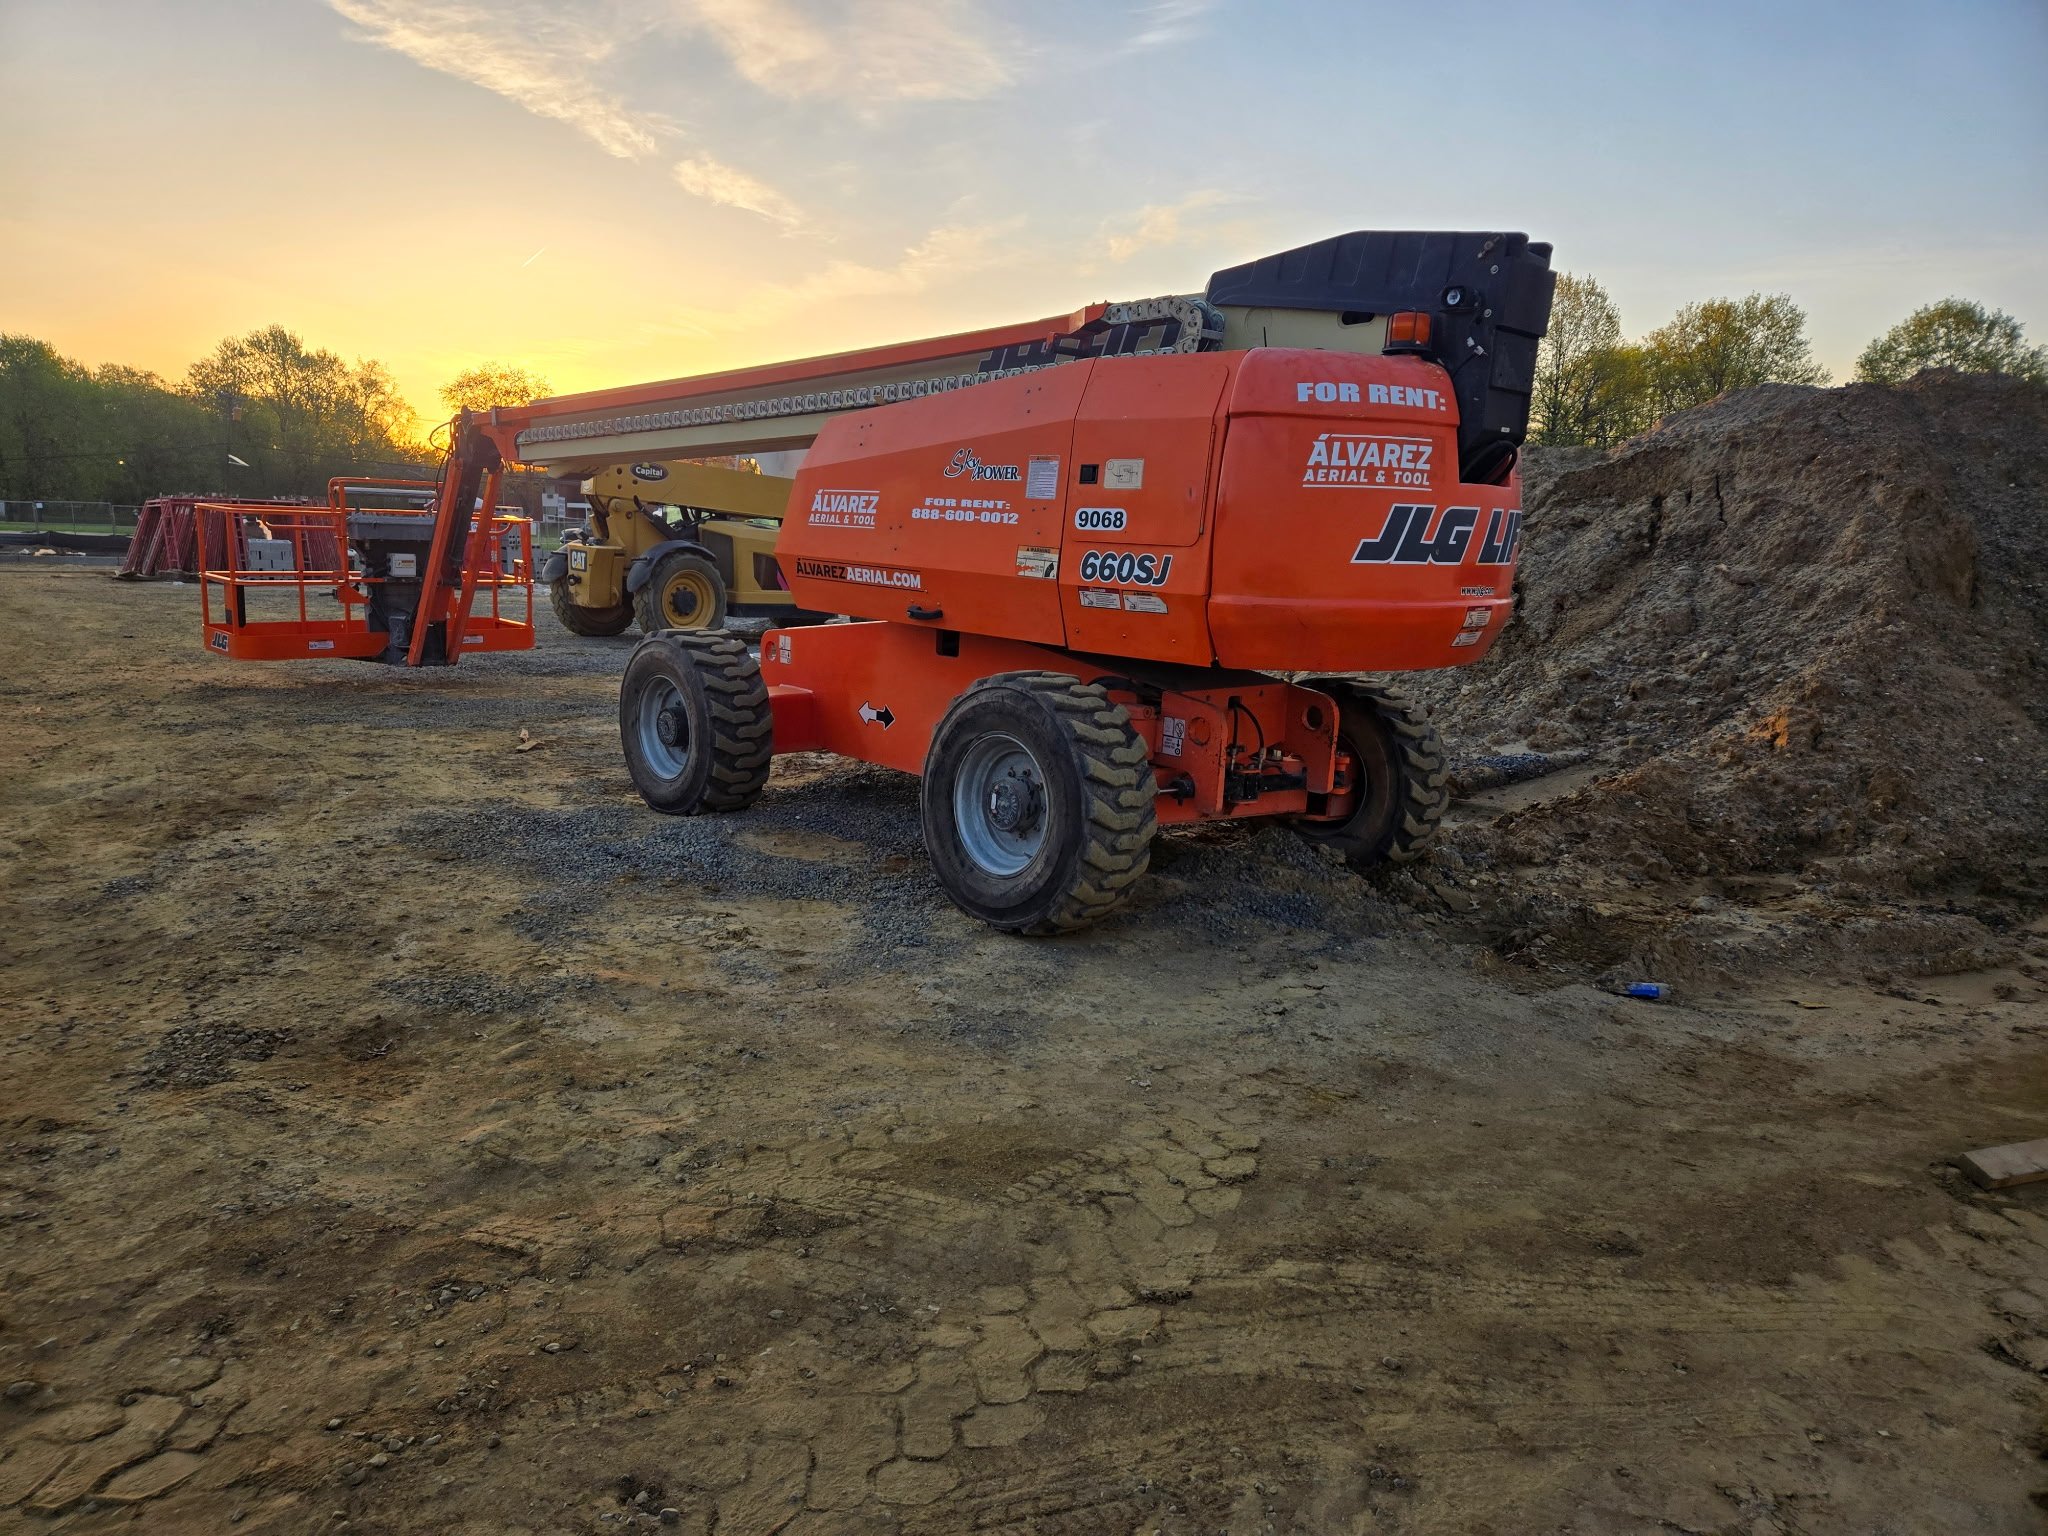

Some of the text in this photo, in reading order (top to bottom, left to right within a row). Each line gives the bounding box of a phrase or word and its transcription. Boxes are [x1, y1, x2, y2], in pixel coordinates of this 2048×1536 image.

[1297, 382, 1446, 411] FOR RENT:
[1306, 433, 1433, 470] ÁLVAREZ
[635, 466, 663, 476] Capital
[1303, 469, 1430, 485] AERIAL & TOOL
[811, 489, 879, 514] ÁLVAREZ
[924, 497, 1011, 510] FOR RENT:
[808, 513, 876, 526] AERIAL & TOOL
[911, 508, 1019, 525] 888-600-0012
[1078, 510, 1124, 528] 9068
[1351, 503, 1480, 566] JLG
[571, 551, 586, 570] CAT
[1080, 550, 1173, 586] 660SJ
[211, 631, 228, 651] JLG
